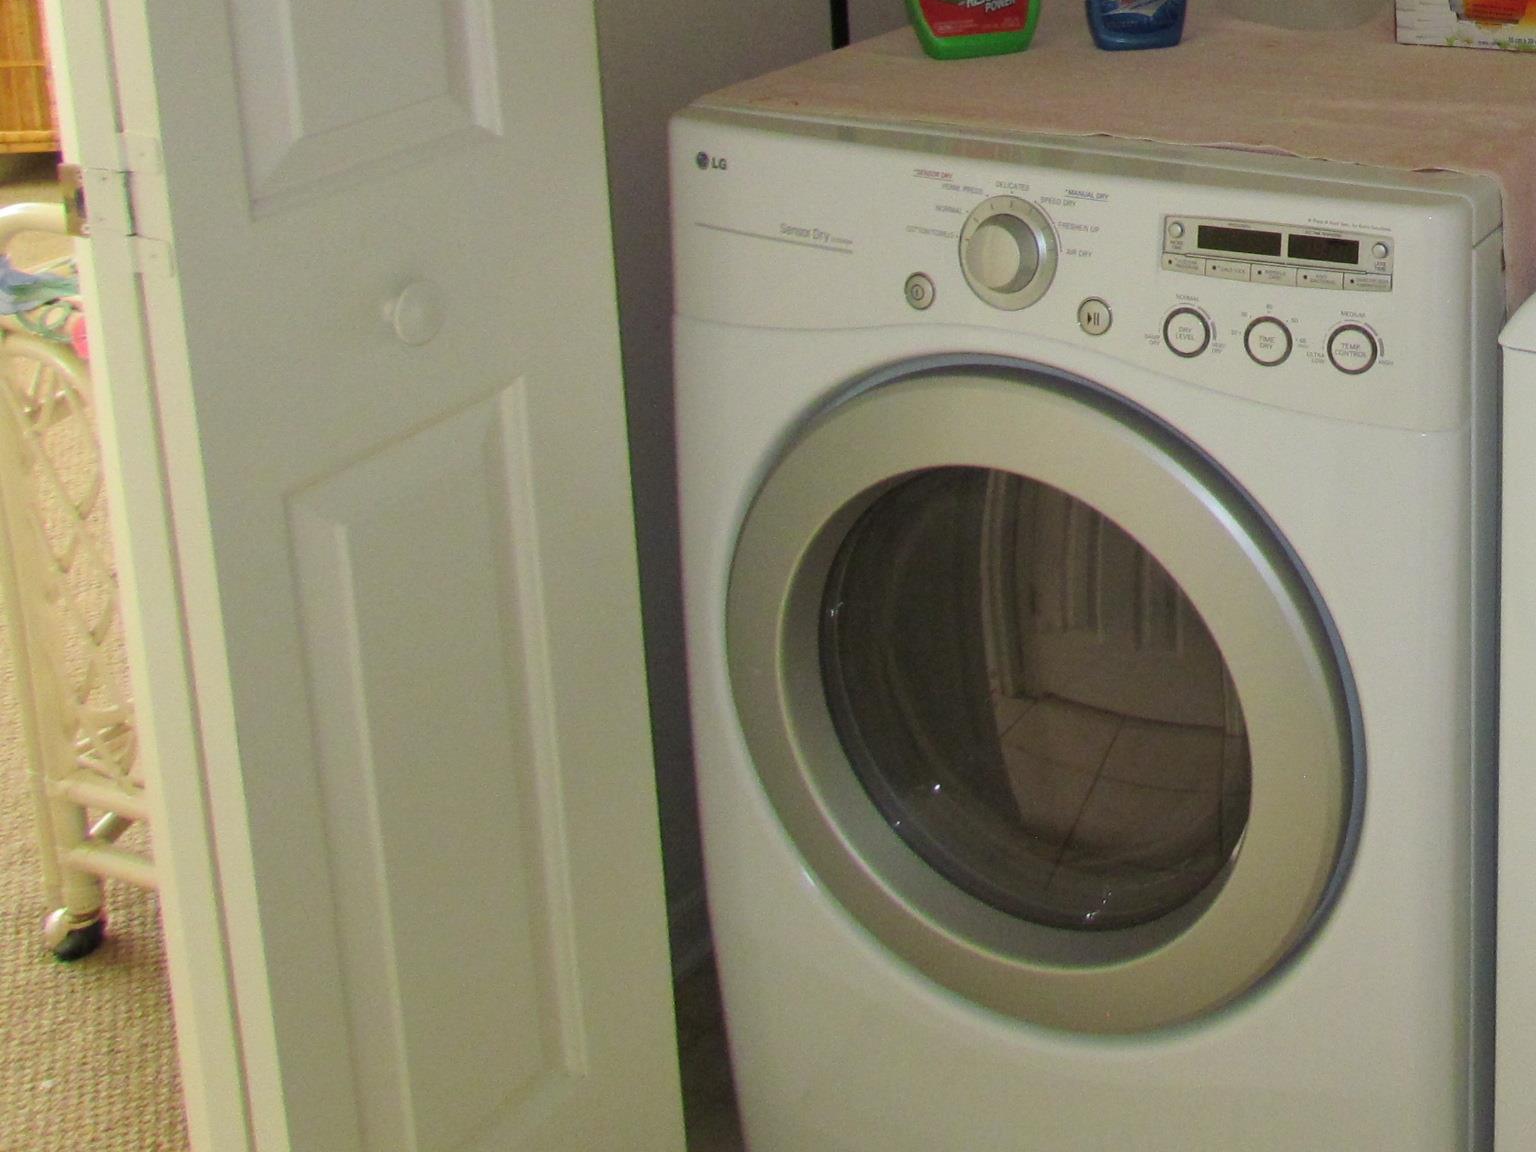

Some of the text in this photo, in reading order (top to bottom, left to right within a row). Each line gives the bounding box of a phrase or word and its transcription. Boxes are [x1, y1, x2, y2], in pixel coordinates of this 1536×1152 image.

[711, 157, 728, 171] LG
[937, 171, 953, 180] DRY
[995, 180, 1030, 192] DELICATES
[1094, 191, 1110, 200] DRY
[1040, 196, 1077, 207] SPEED DRY
[935, 204, 963, 214] NORMAL
[1057, 221, 1100, 233] FRESHEN UP
[779, 222, 811, 239] Sensor
[811, 227, 831, 243] Dry
[1065, 249, 1093, 258] AIR DRY
[1178, 326, 1193, 334] DRY
[1174, 332, 1196, 342] LEVEL
[1258, 335, 1276, 344] TIME
[1259, 342, 1274, 351] DRY
[1334, 349, 1368, 359] CONTROL
[1378, 359, 1394, 367] HIGH
